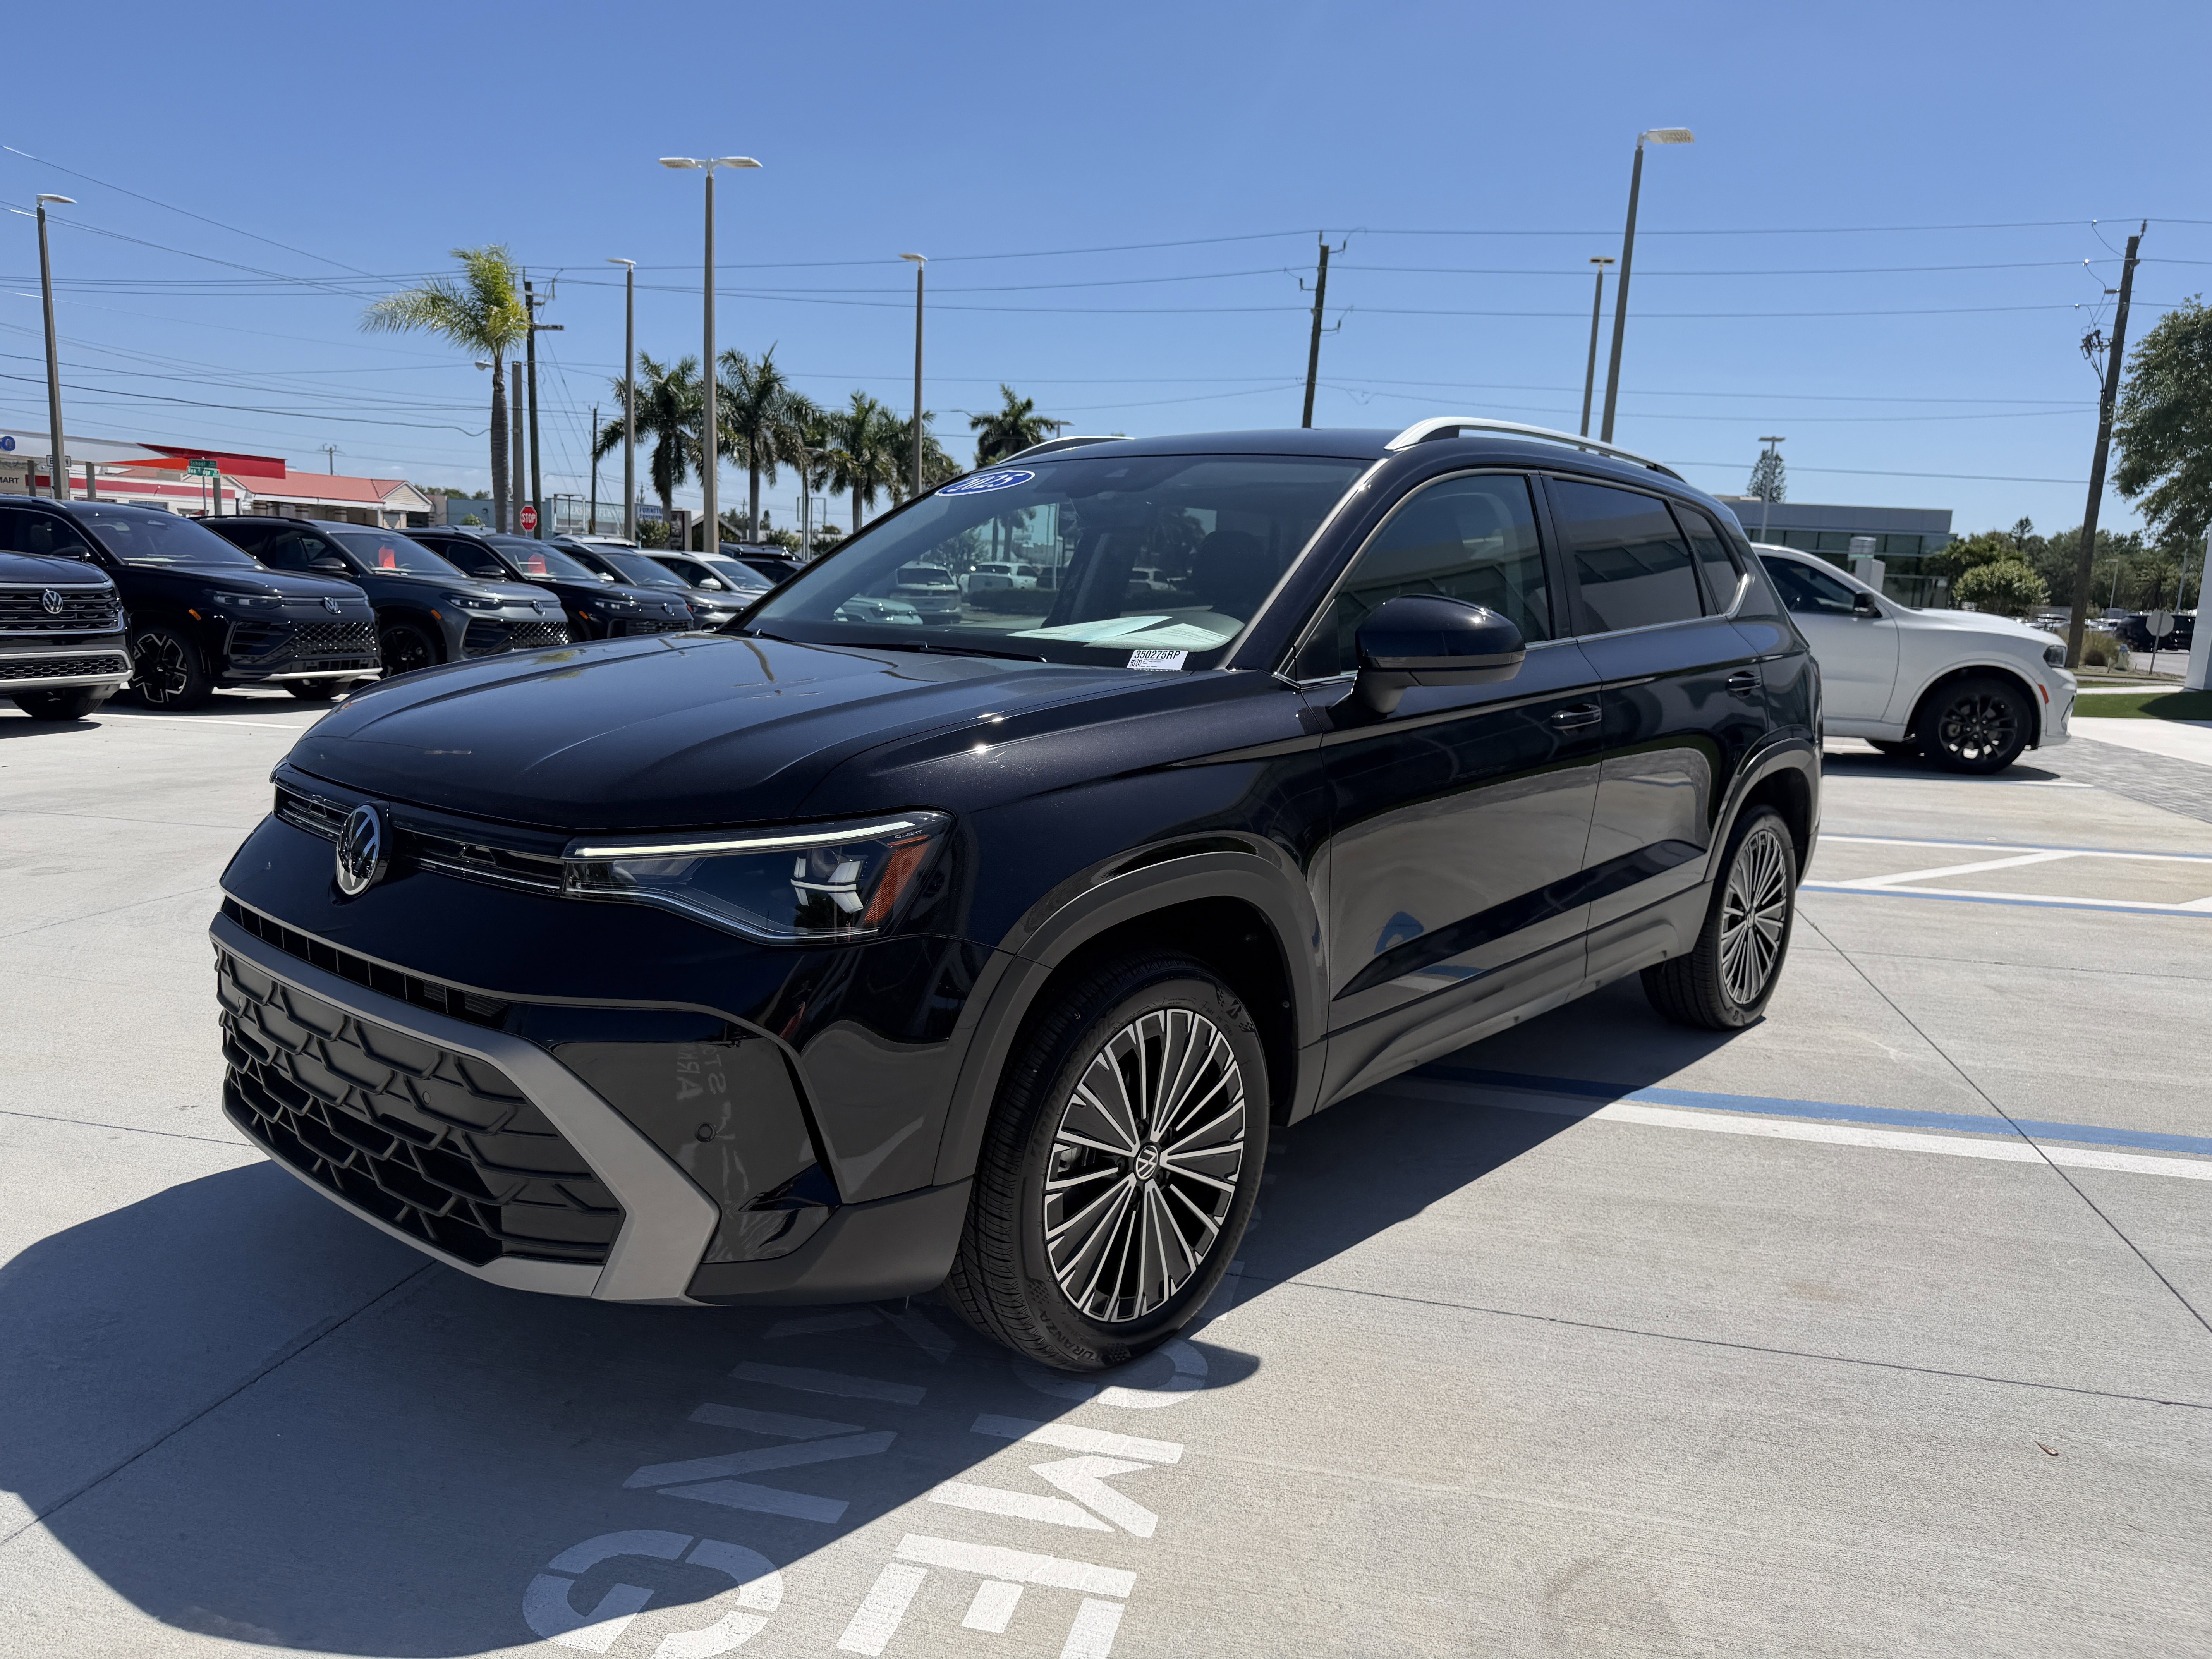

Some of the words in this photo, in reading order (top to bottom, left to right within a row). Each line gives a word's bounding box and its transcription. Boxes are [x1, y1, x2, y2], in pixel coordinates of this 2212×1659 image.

[947, 474, 1027, 492] 2025
[521, 512, 537, 523] STOP
[1134, 650, 1180, 659] 350275RP
